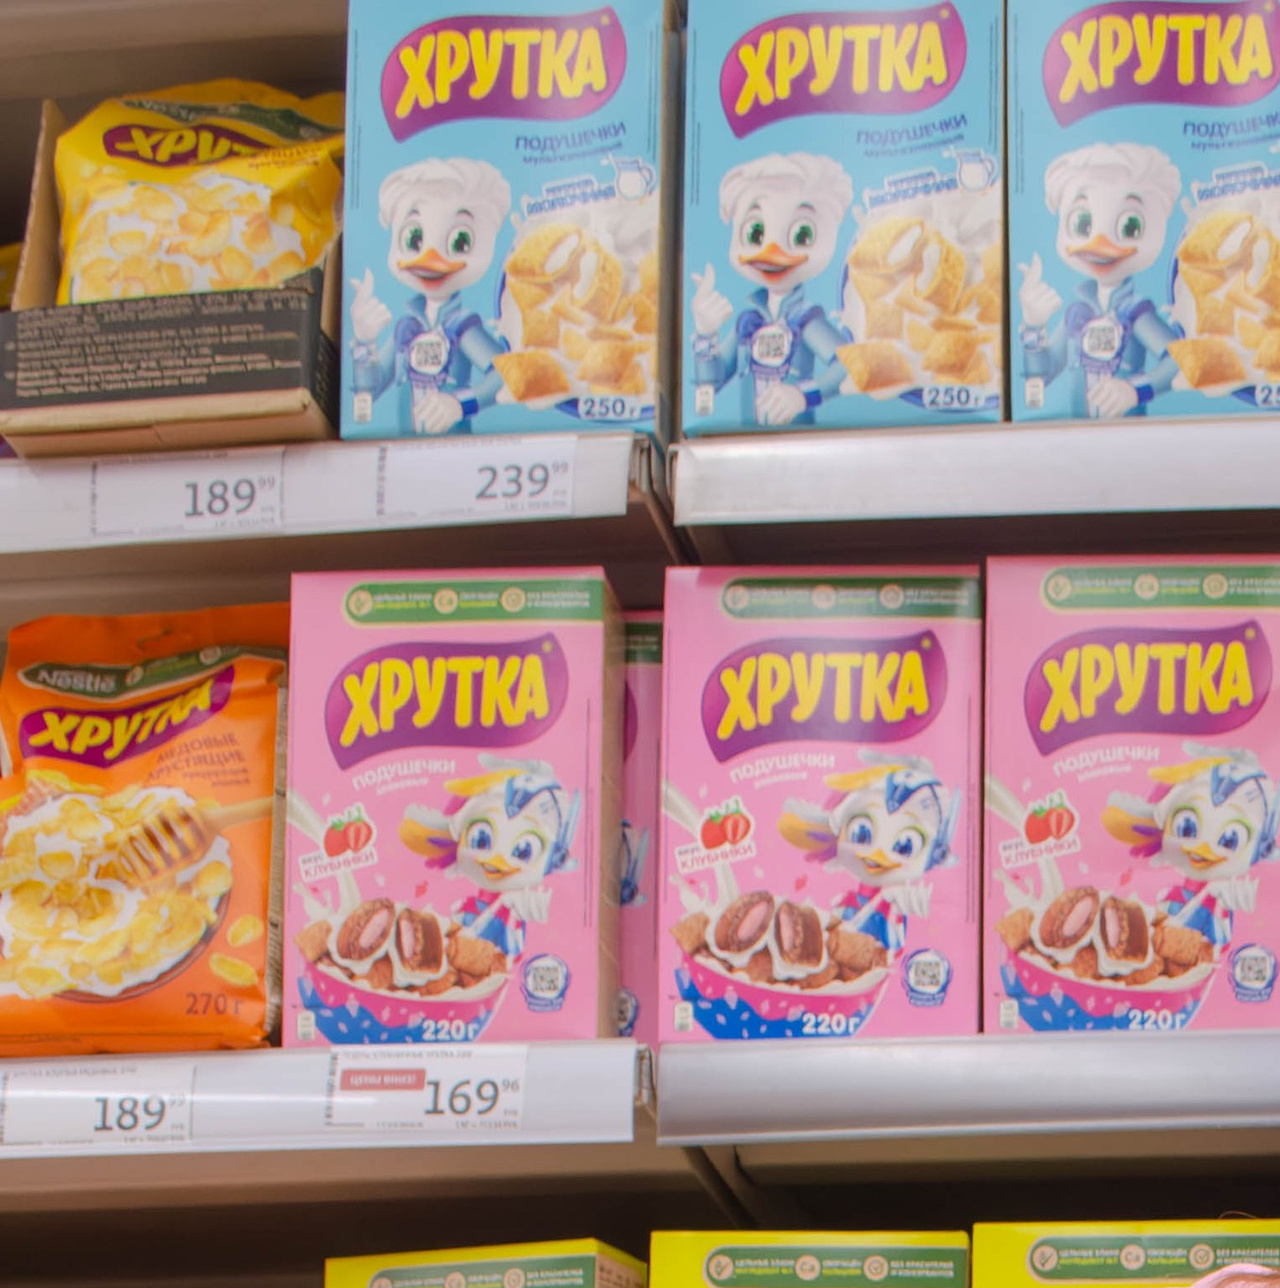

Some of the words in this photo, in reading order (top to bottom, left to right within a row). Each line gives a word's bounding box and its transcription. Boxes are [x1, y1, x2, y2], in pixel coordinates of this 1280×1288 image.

[395, 27, 608, 118] ХРУТКА
[736, 20, 949, 116] ХРУТКА
[1059, 13, 1274, 103] ХРУТКА
[515, 122, 626, 154] ПОДУШЕЧКИ
[856, 114, 968, 145] ПОДУШЕЧКИ
[583, 397, 626, 418] 250
[927, 386, 971, 406] 250
[184, 477, 257, 519] 189
[258, 475, 275, 491] 99
[474, 463, 551, 500] 239
[552, 460, 569, 476] 99
[340, 654, 550, 748] ХРУТКА
[716, 650, 930, 741] ХРУТКА
[1040, 641, 1254, 733] ХРУТКА
[29, 679, 214, 760] ХРУТКА
[352, 759, 456, 791] ПОДУШЕЧКИ
[729, 753, 835, 783] ПОДУШЕЧКИ
[1053, 746, 1160, 777] ПОДУШЕЧКИ
[185, 993, 228, 1016] 270
[94, 1095, 167, 1131] 189
[424, 1080, 500, 1116] 169
[501, 1079, 520, 1092] 96
